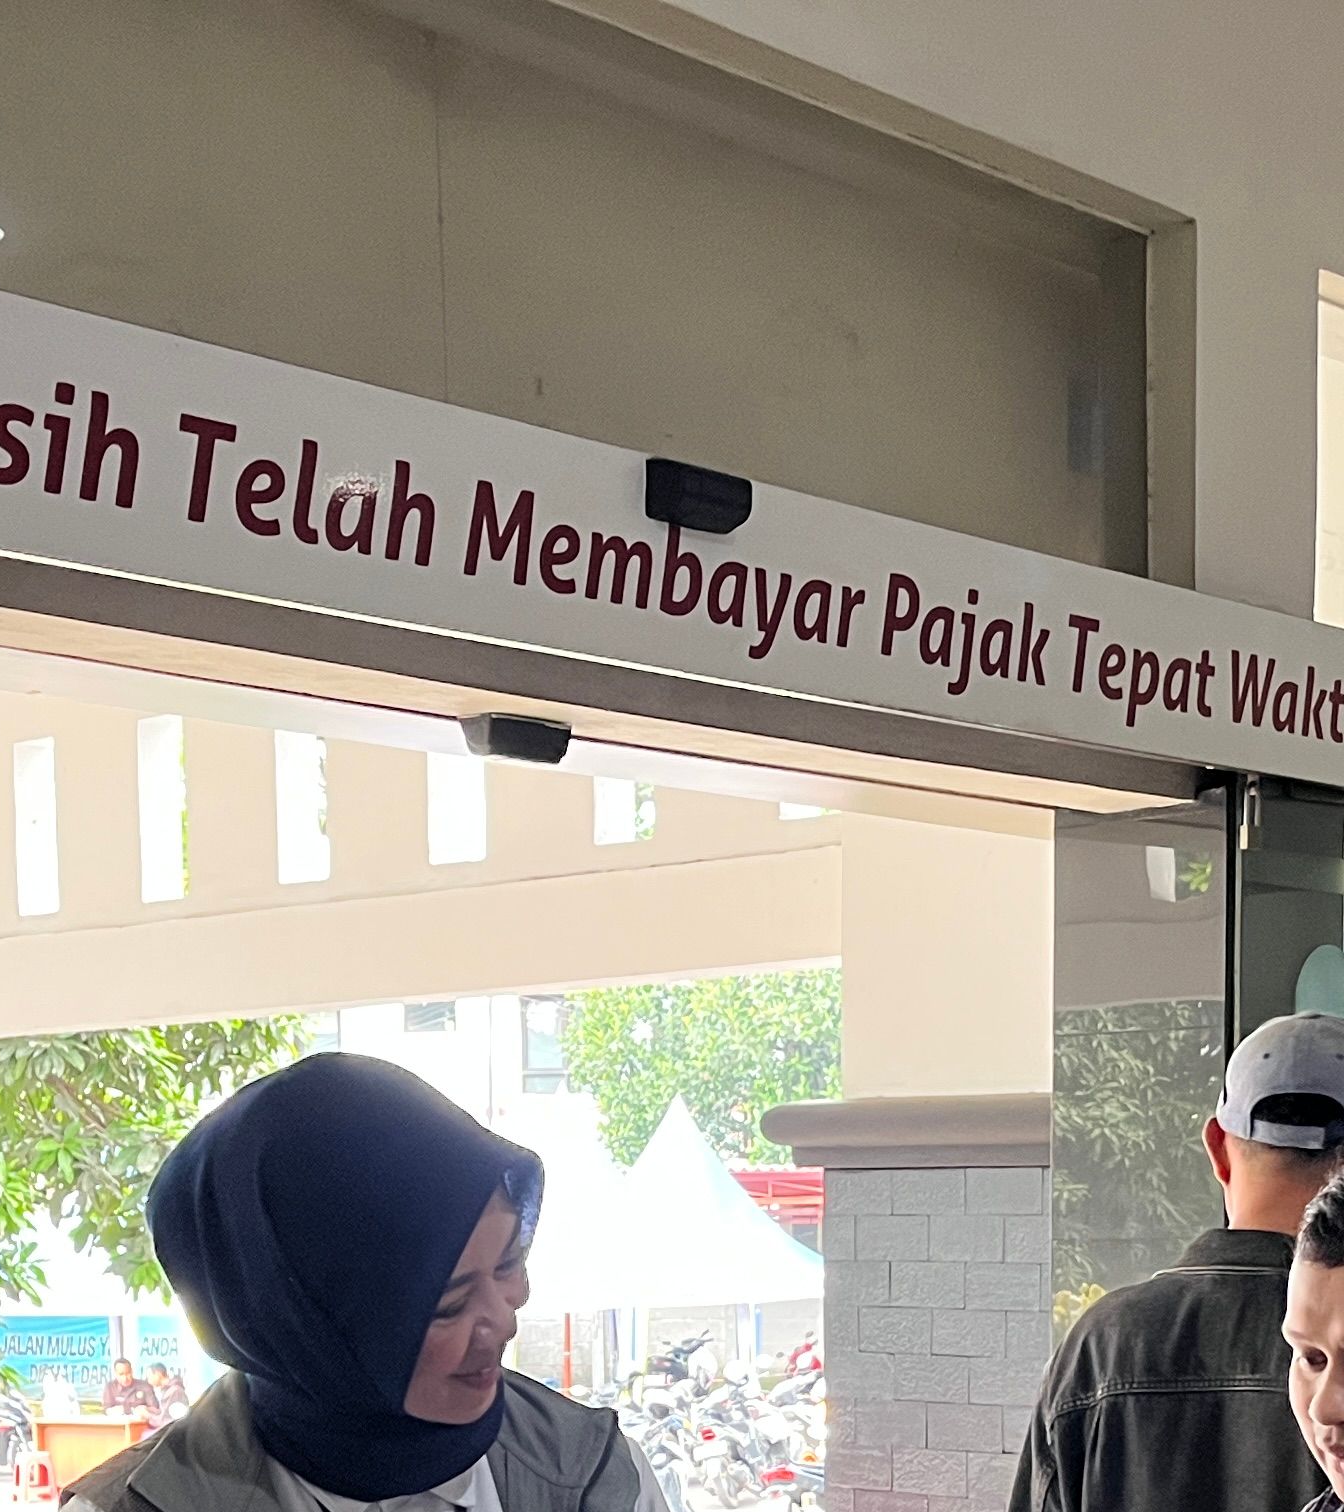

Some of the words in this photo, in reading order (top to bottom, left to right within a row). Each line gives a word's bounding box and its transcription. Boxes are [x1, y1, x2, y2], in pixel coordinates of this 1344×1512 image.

[178, 413, 436, 567] Telah
[463, 480, 867, 659] Membayar
[880, 572, 1050, 695] Pajak
[1067, 613, 1215, 727] Tepat
[0, 1335, 45, 1356] JALAN
[47, 1335, 96, 1358] MULUS
[140, 1337, 179, 1357] ANDA
